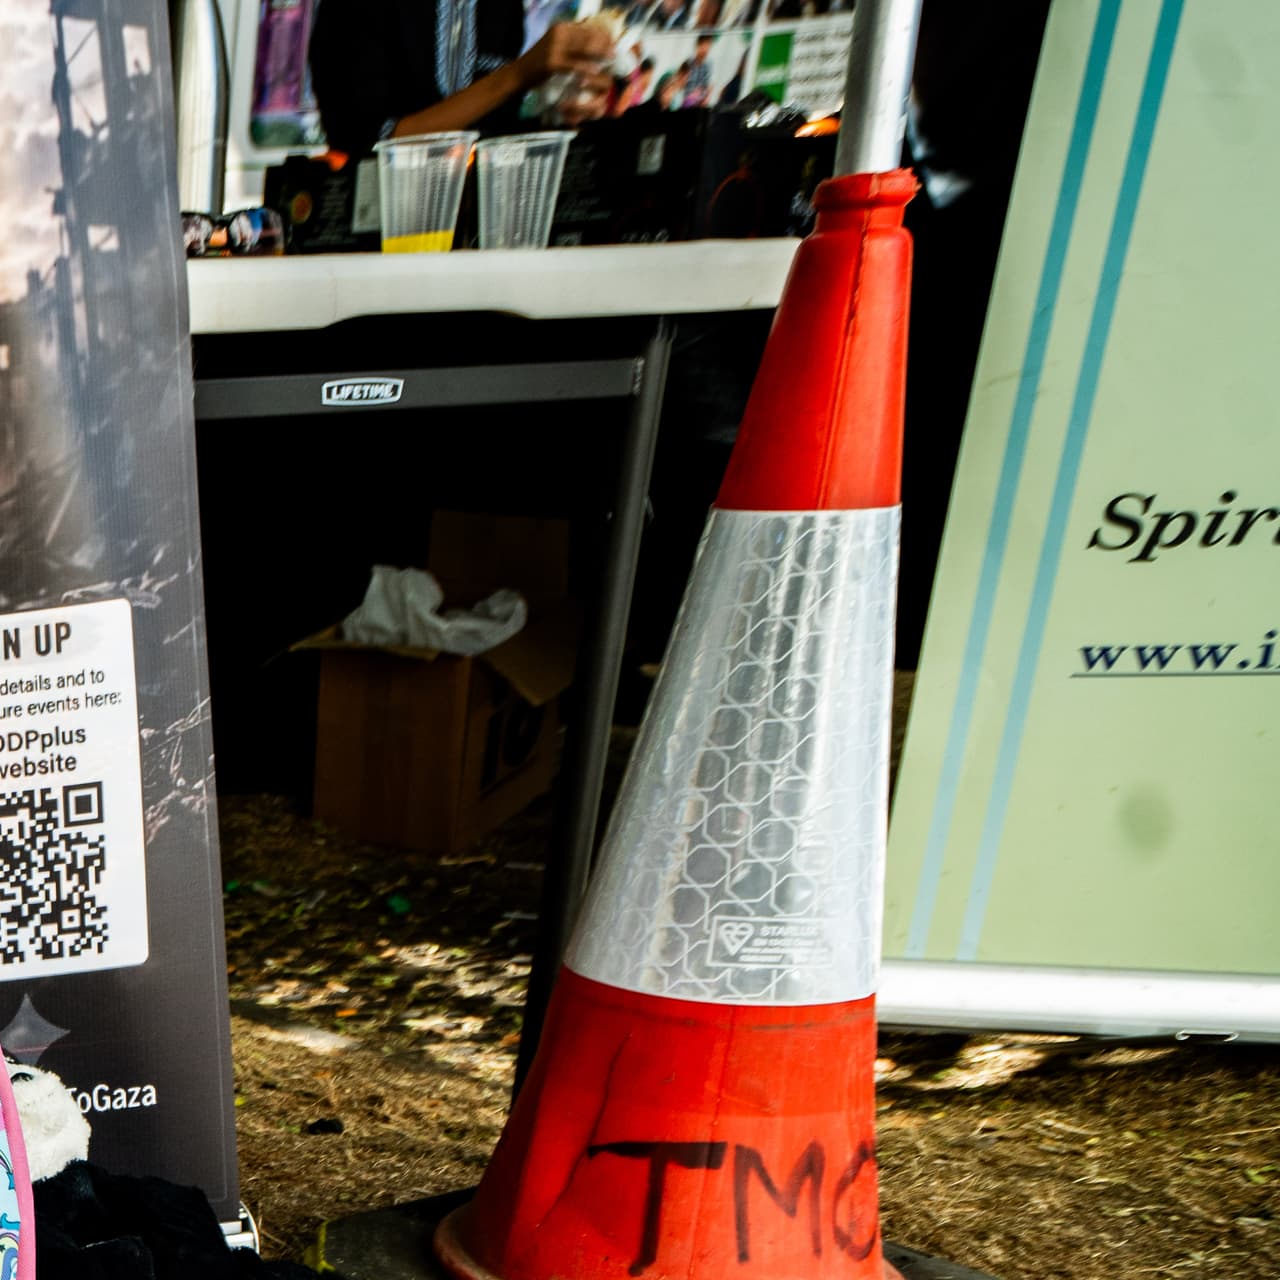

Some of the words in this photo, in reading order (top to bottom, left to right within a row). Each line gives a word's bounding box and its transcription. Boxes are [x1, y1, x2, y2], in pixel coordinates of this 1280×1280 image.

[331, 383, 394, 400] LIFETIME
[1086, 489, 1280, 563] Spir
[34, 622, 72, 656] UP
[1080, 629, 1280, 671] www.i
[0, 675, 52, 697] details
[56, 669, 86, 688] and
[90, 669, 105, 684] to
[27, 696, 80, 716] events
[85, 691, 122, 709] here:
